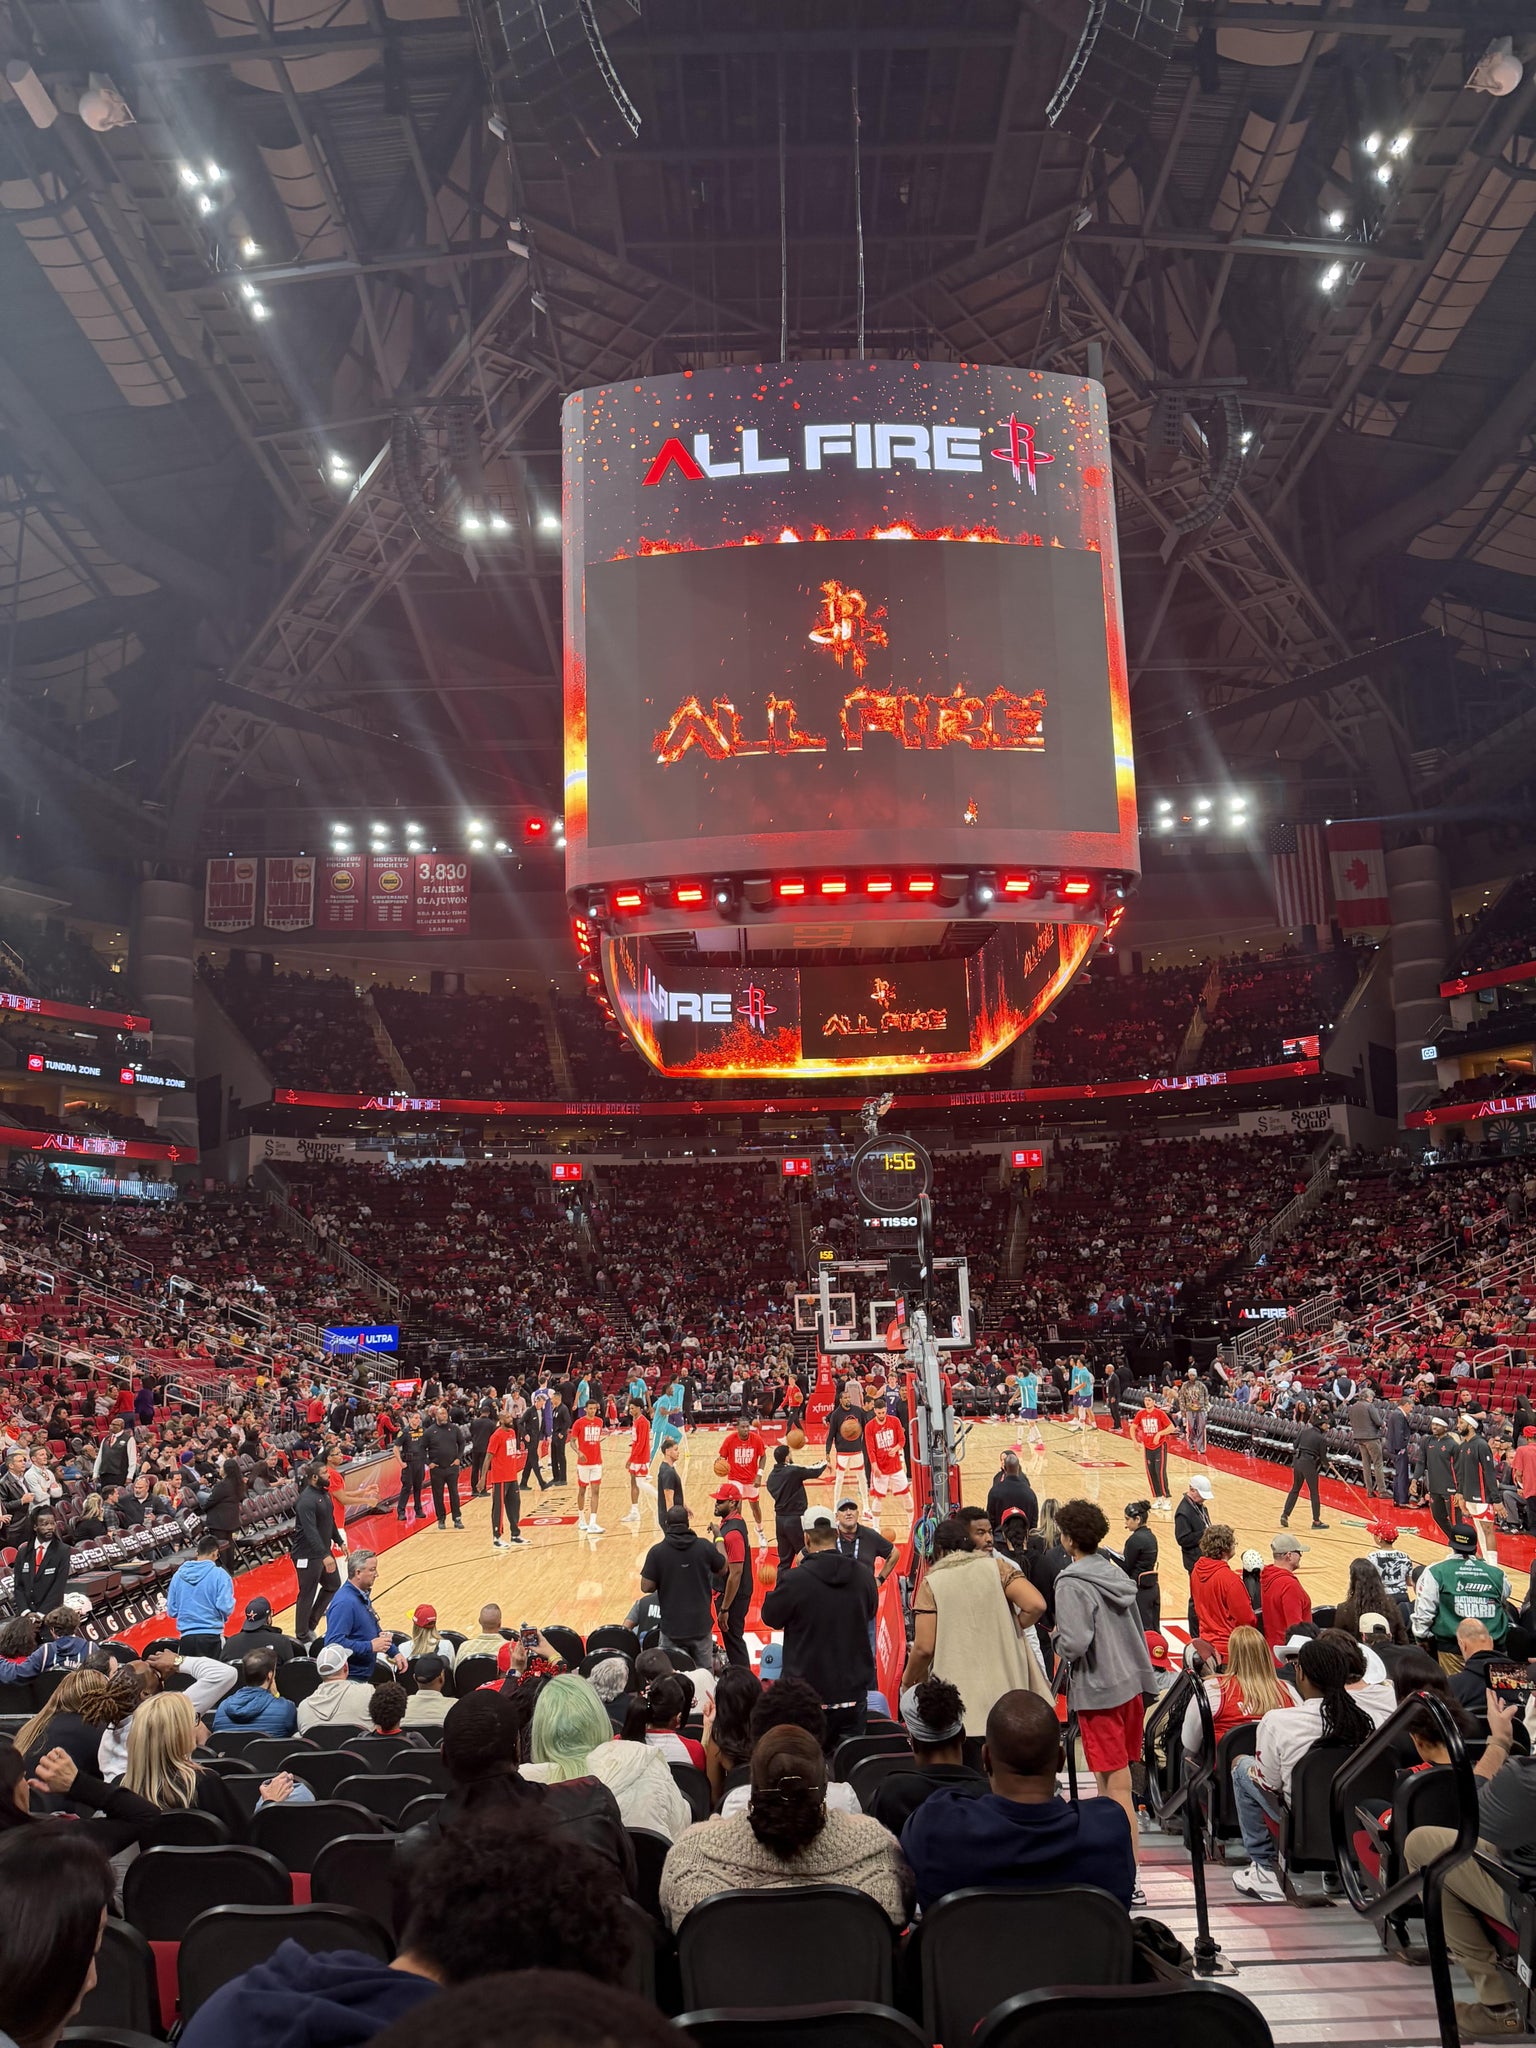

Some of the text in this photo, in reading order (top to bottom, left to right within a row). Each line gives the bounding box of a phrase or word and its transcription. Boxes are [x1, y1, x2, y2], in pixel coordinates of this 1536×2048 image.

[642, 429, 789, 486] ALL
[804, 424, 983, 471] FIRE
[653, 685, 1047, 763] ALL FIRE
[419, 863, 467, 883] 3,830
[423, 885, 464, 893] HAKEEM
[416, 897, 468, 906] OLAJUWON
[45, 1060, 101, 1076] TUNDRA ZONE
[135, 1073, 186, 1089] TUNDRA ZONE
[950, 1090, 1026, 1106] HOUSTON ROCKETS
[566, 1103, 641, 1115] HOUSTON ROCKETS
[1291, 1107, 1331, 1123] Social
[1478, 1099, 1515, 1117] ALL
[1297, 1118, 1327, 1130] Club
[43, 1134, 81, 1150] ALL
[885, 1153, 915, 1170] 1:56
[881, 1217, 918, 1227] TISSO
[1239, 1307, 1287, 1319] ALL FIRE
[365, 1334, 394, 1344] ULTRA
[812, 1403, 835, 1413] xfinit
[889, 1396, 896, 1404] 7
[141, 1599, 154, 1615] G
[1454, 1602, 1496, 1618] GUARD
[106, 1615, 119, 1632] G
[124, 1607, 137, 1624] G
[86, 1623, 99, 1640] G
